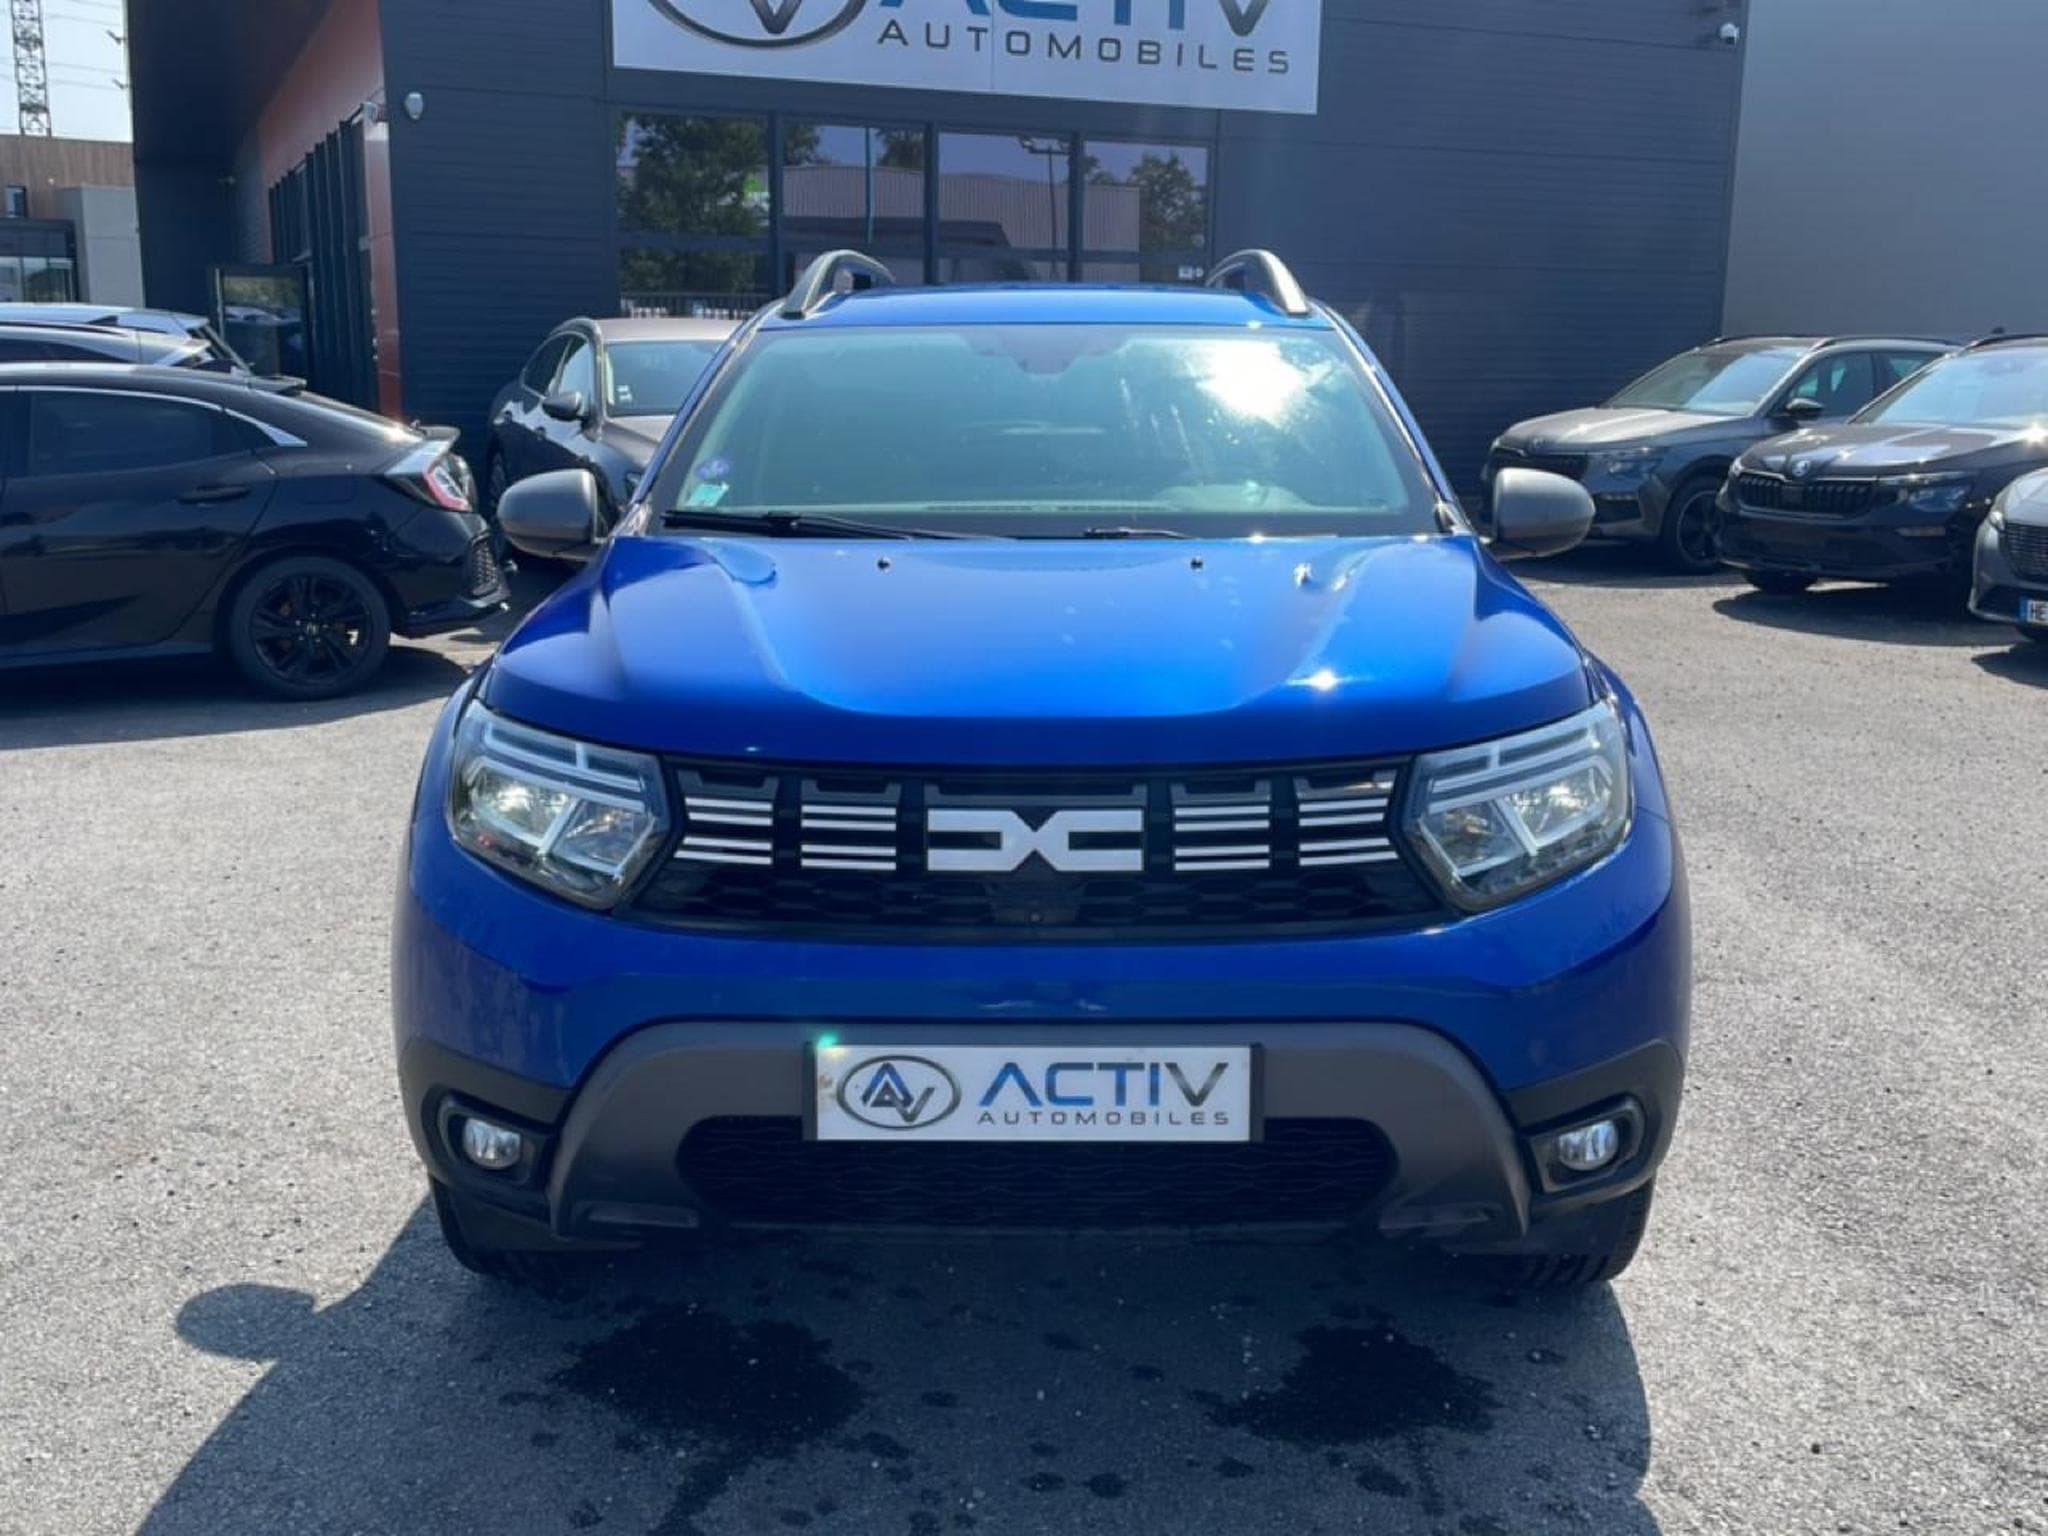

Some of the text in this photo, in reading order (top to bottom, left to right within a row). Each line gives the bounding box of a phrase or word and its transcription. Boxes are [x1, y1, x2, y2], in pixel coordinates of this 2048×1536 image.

[877, 19, 1290, 74] AUTOMOBILES
[978, 1061, 1230, 1107] ACTIV
[977, 1110, 1230, 1126] AUTOMOBILES
